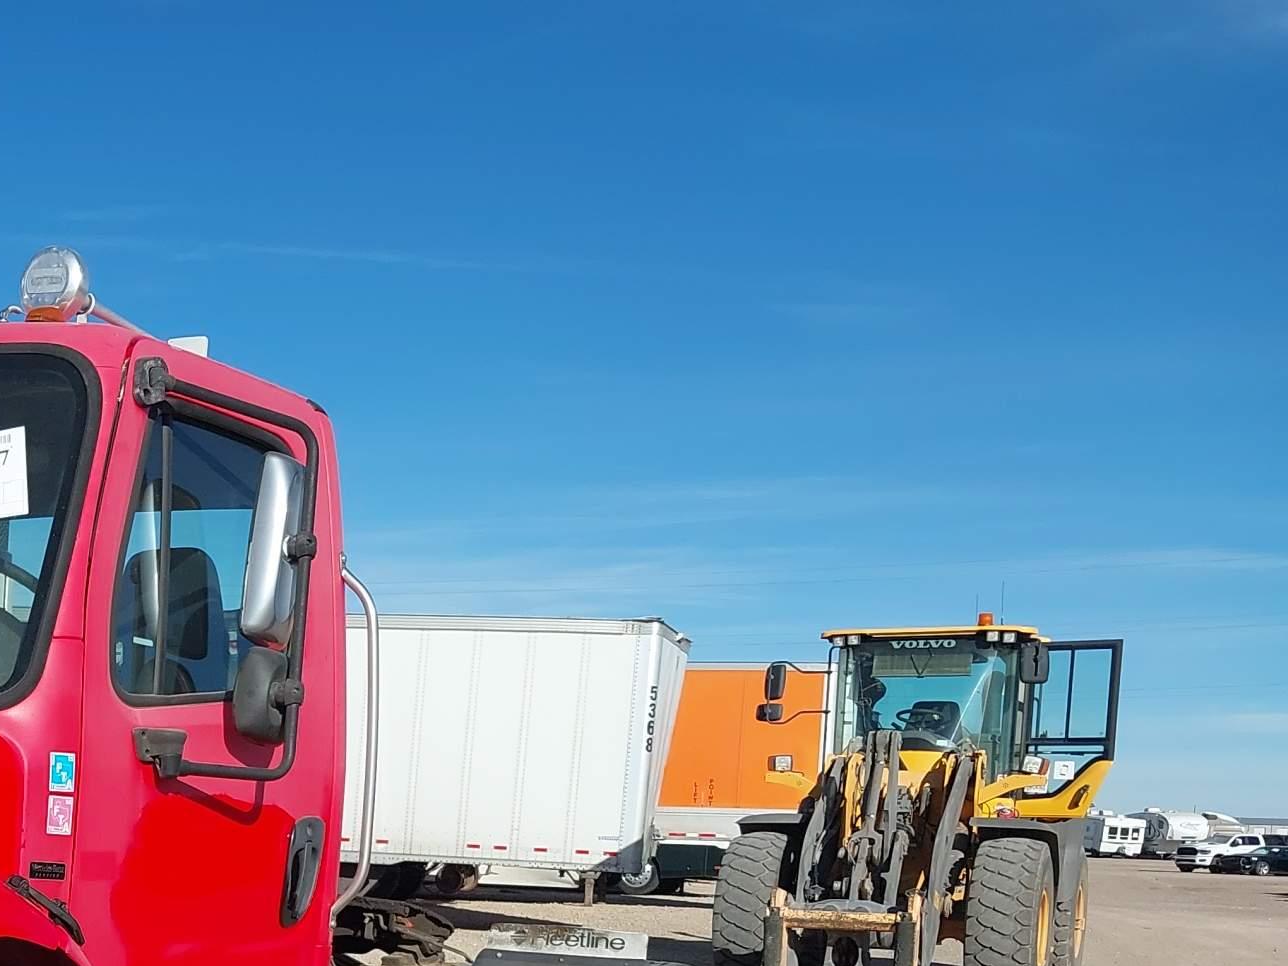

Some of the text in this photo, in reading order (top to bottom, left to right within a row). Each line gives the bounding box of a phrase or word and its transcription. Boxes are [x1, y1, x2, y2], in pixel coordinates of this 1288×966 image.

[889, 639, 957, 649] VOLVO
[645, 686, 658, 752] 5368
[531, 928, 626, 951] Fleetline
